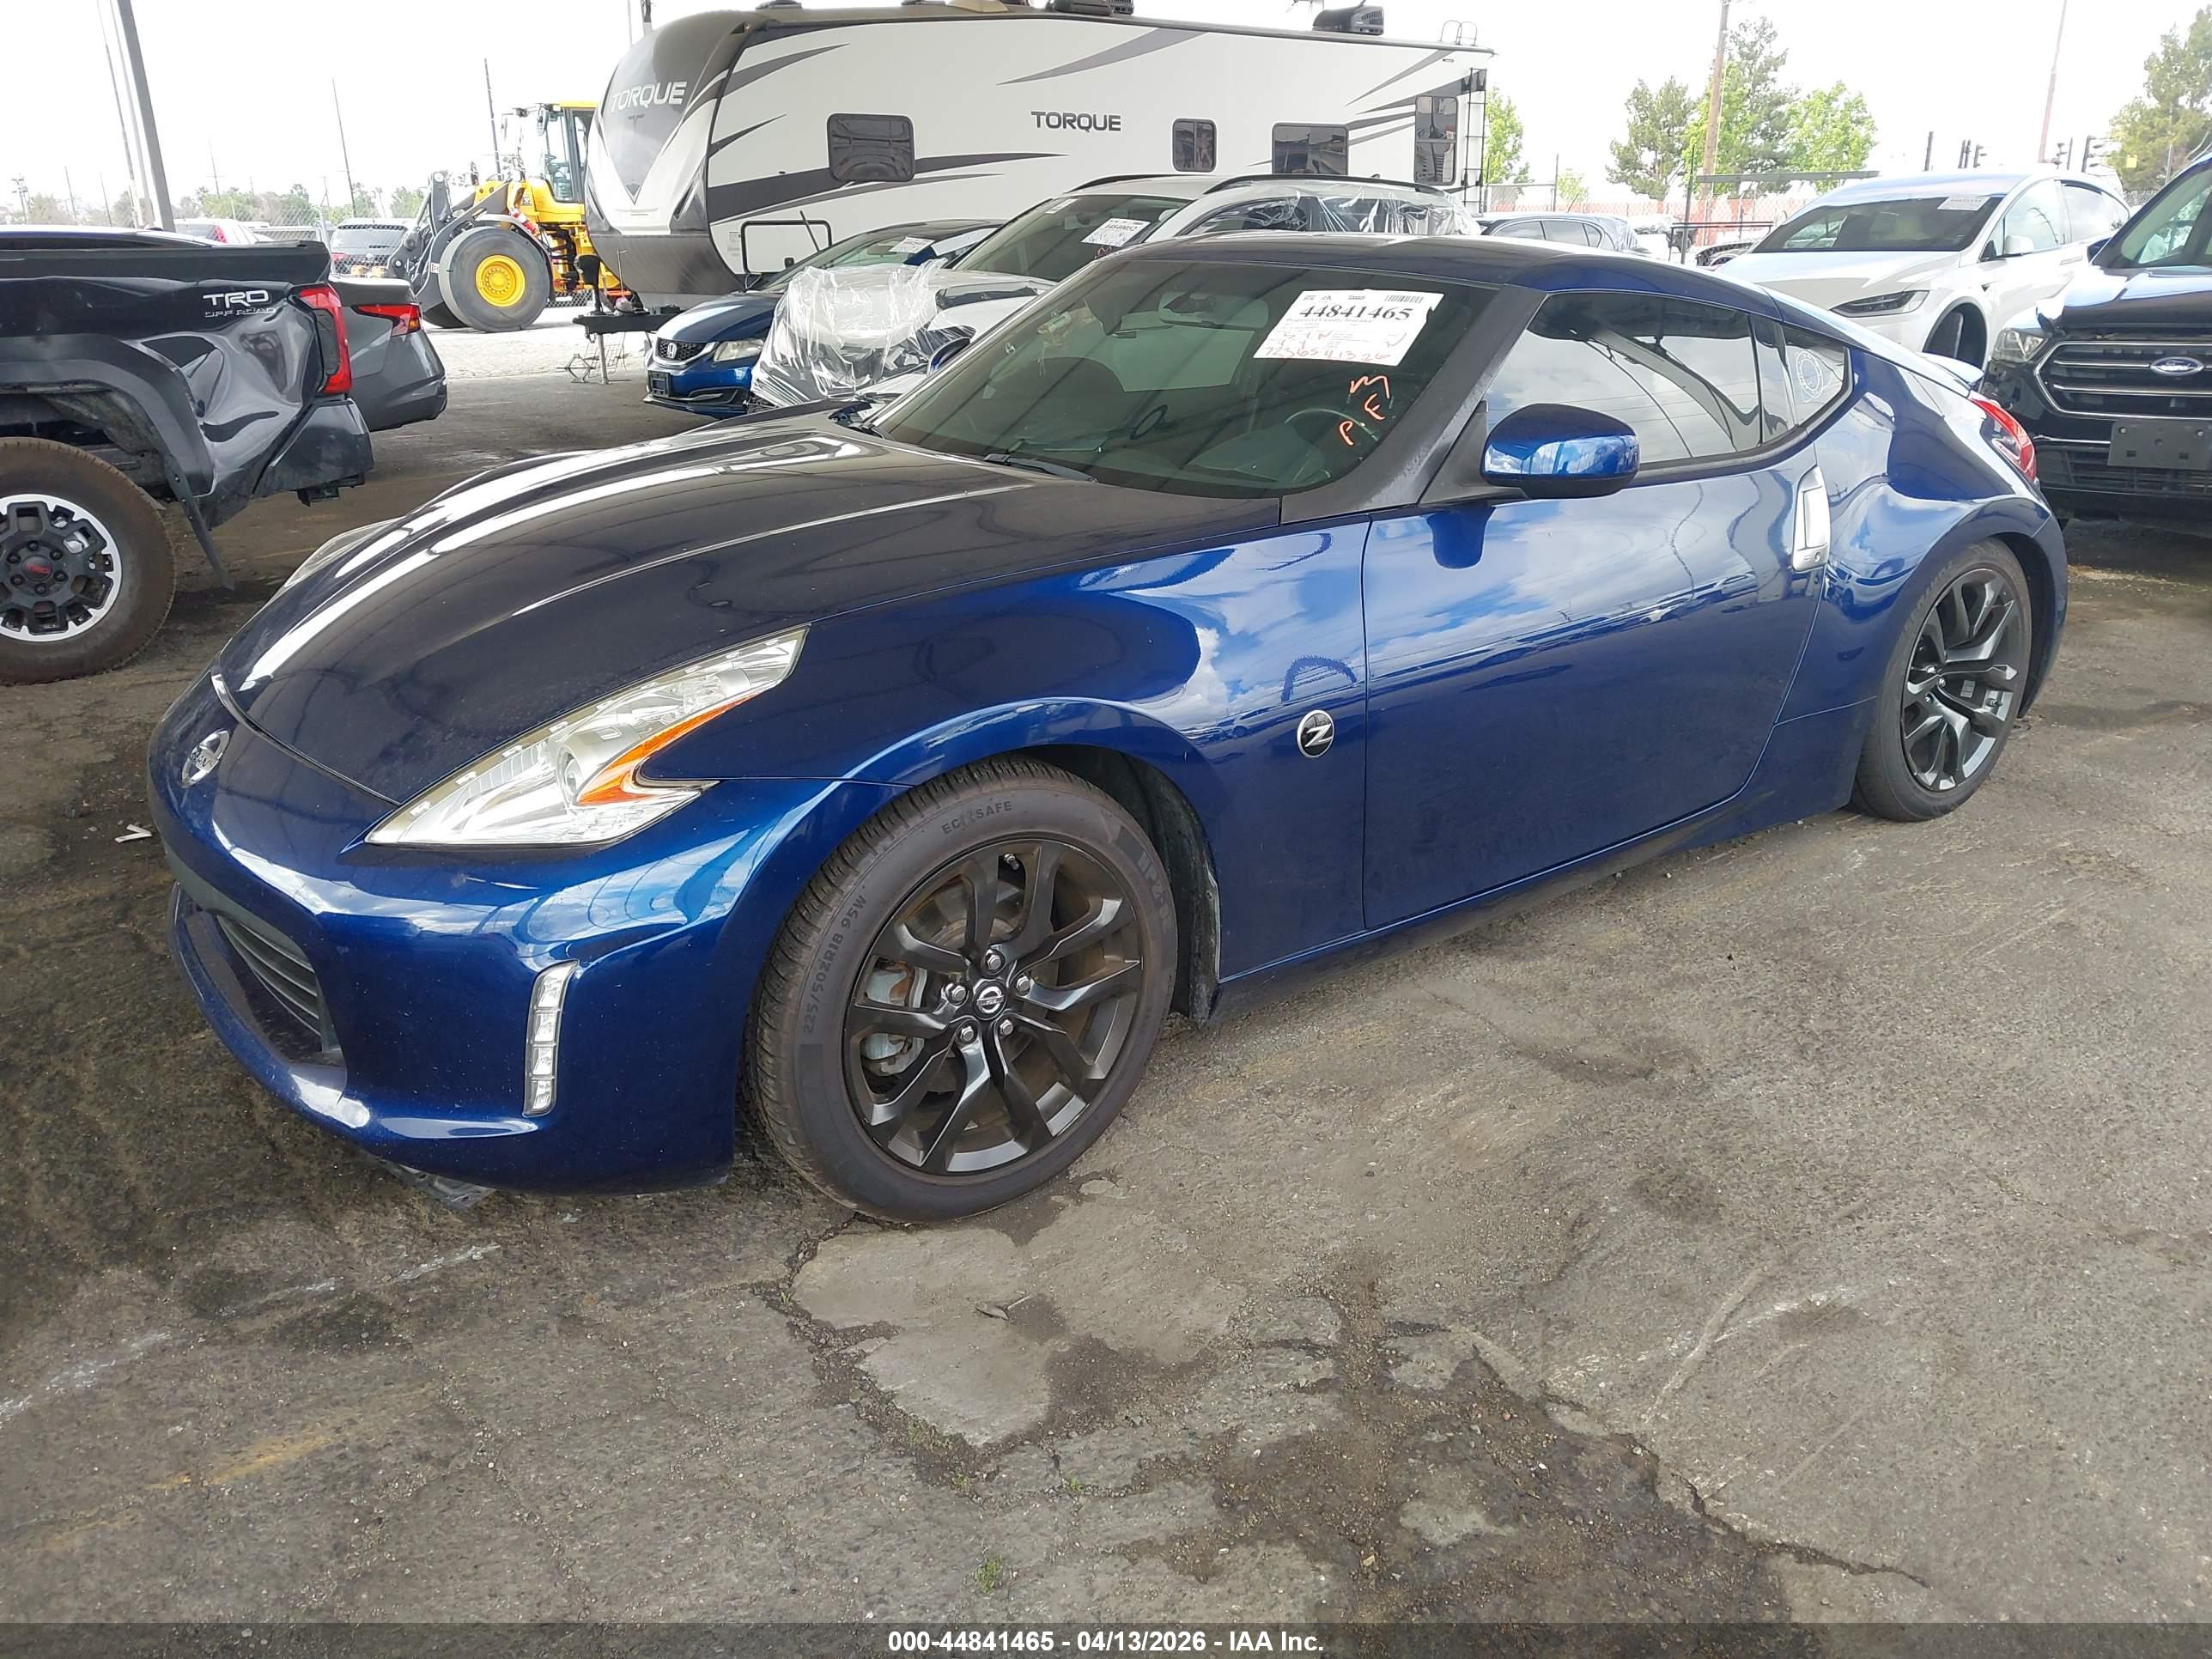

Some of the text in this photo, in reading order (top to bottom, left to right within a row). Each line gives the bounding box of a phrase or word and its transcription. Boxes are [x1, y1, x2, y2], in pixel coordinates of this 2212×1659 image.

[611, 82, 687, 112] TORQUE
[1030, 111, 1121, 133] TORQUE
[203, 290, 269, 308] TRD
[1299, 304, 1414, 321] 44841465
[841, 896, 867, 930] 95W
